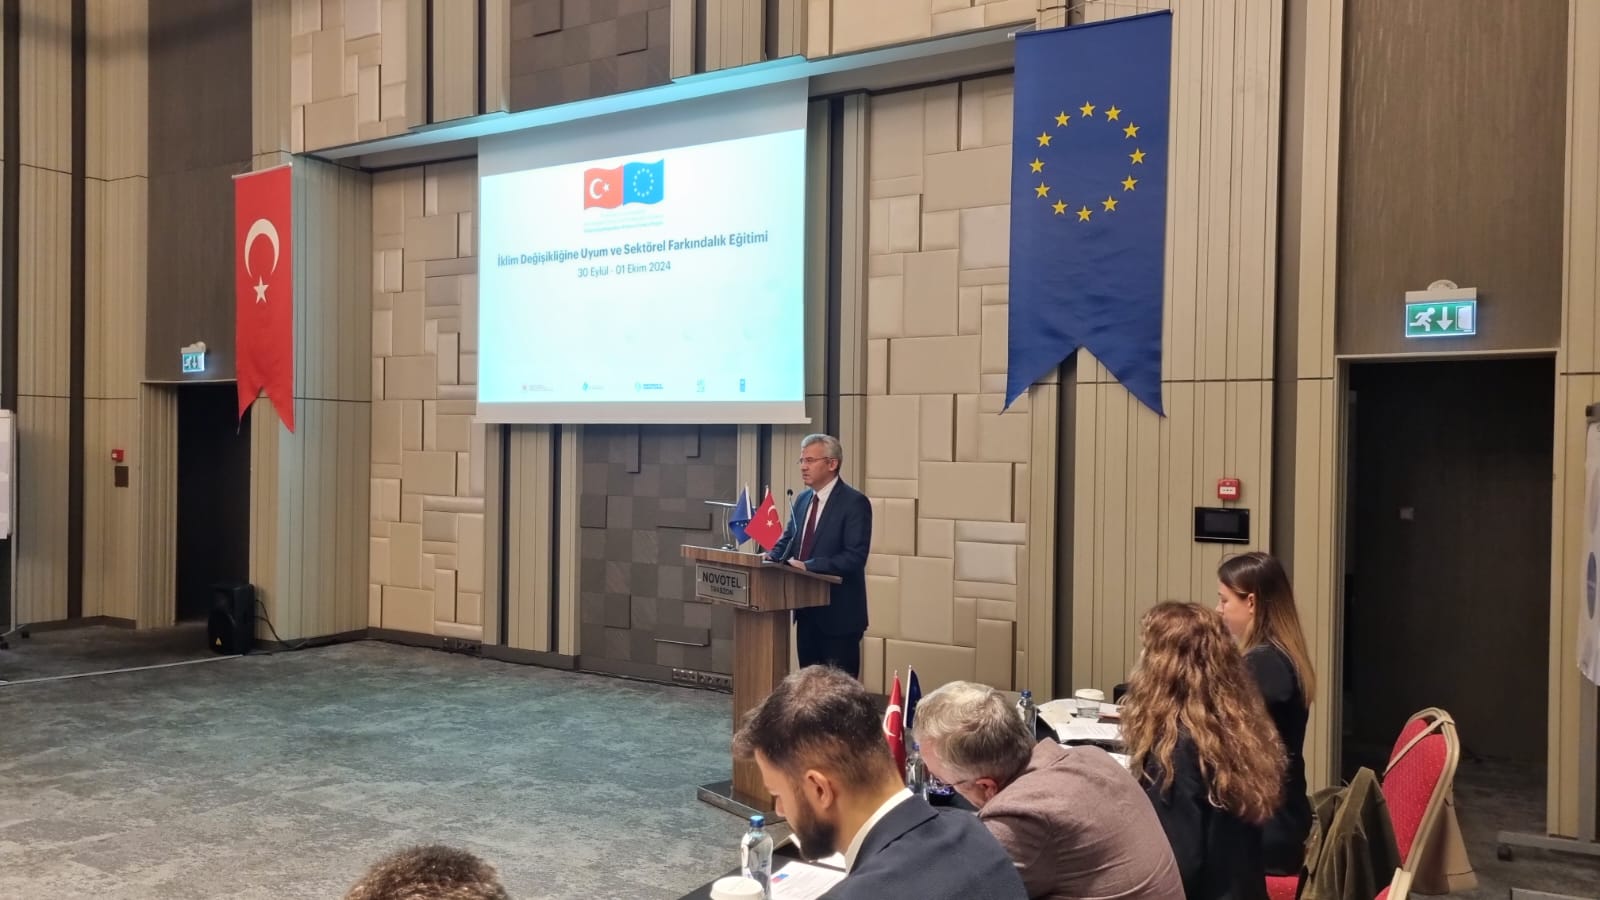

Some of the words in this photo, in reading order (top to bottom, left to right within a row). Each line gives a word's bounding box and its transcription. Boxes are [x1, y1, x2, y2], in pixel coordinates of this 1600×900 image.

[497, 253, 519, 267] İklim
[520, 249, 579, 265] Değişikliğine
[581, 248, 608, 260] Uyum
[610, 247, 622, 256] ve
[624, 240, 666, 255] Sektörel
[668, 234, 726, 251] Farkındalık
[729, 230, 769, 248] Eğitimi
[577, 267, 588, 278] 30
[590, 265, 609, 278] Eylül
[615, 264, 625, 275] 01
[627, 263, 647, 274] Ekim
[649, 261, 671, 272] 2024
[702, 571, 742, 588] NOVOTEL
